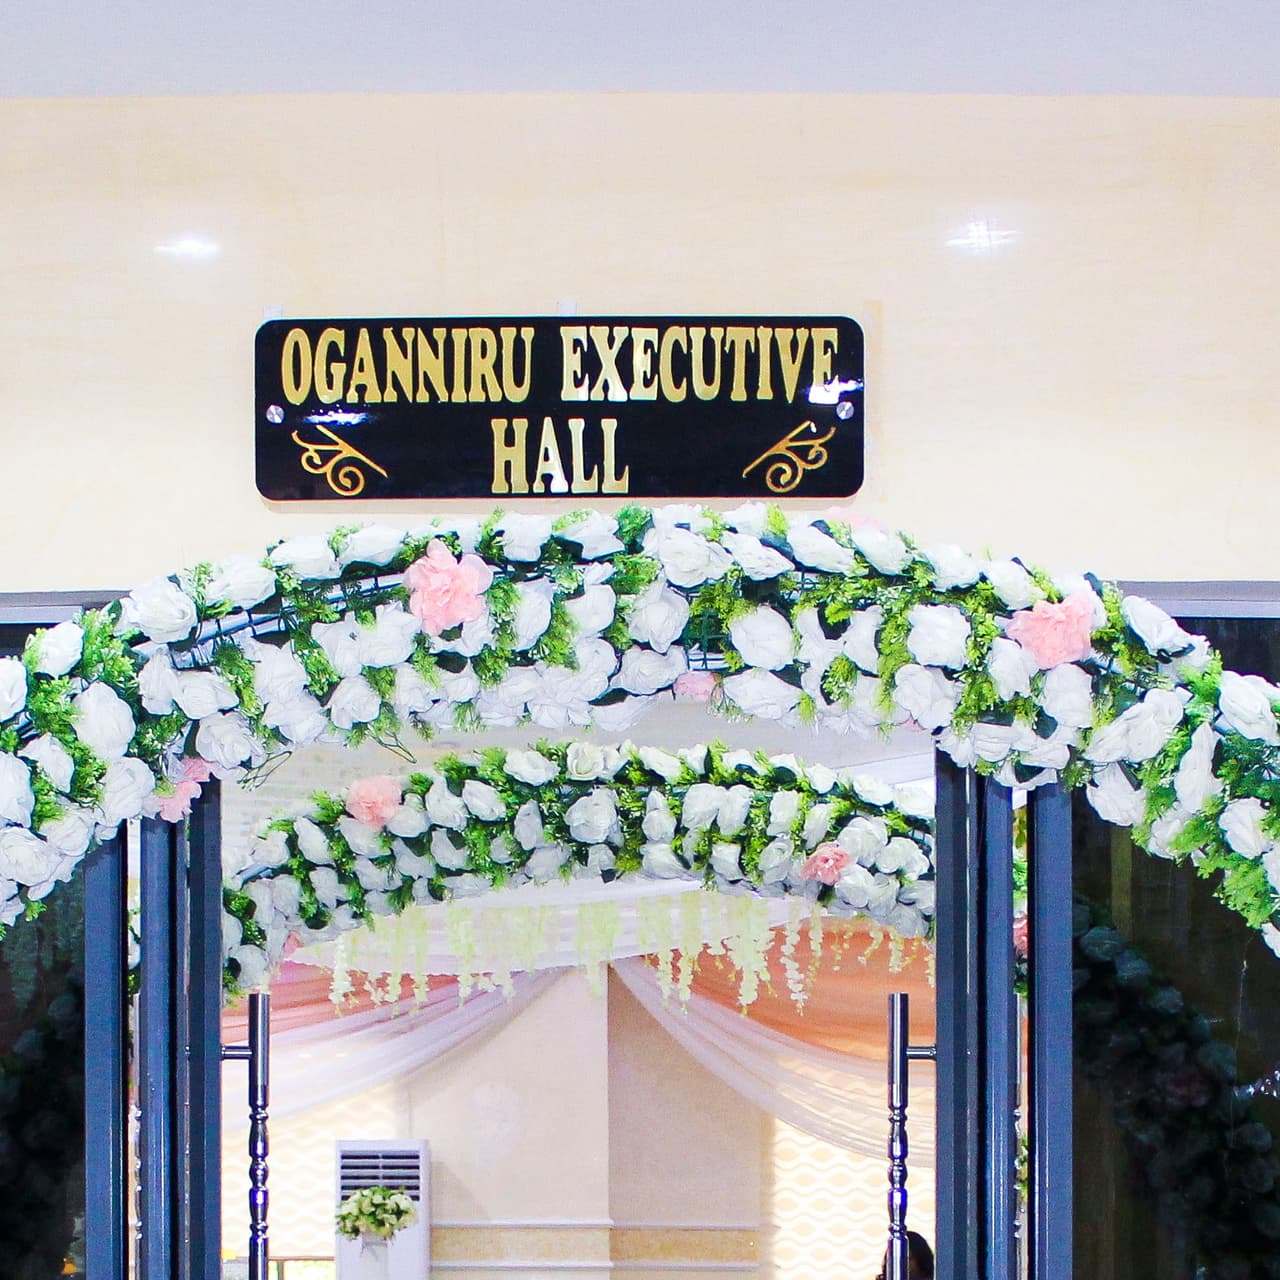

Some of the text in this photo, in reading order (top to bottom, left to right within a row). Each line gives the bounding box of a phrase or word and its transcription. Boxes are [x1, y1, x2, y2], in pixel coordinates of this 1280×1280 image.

[281, 325, 839, 405] OGANNIRU EXECUTIVE
[491, 416, 630, 494] HALL
